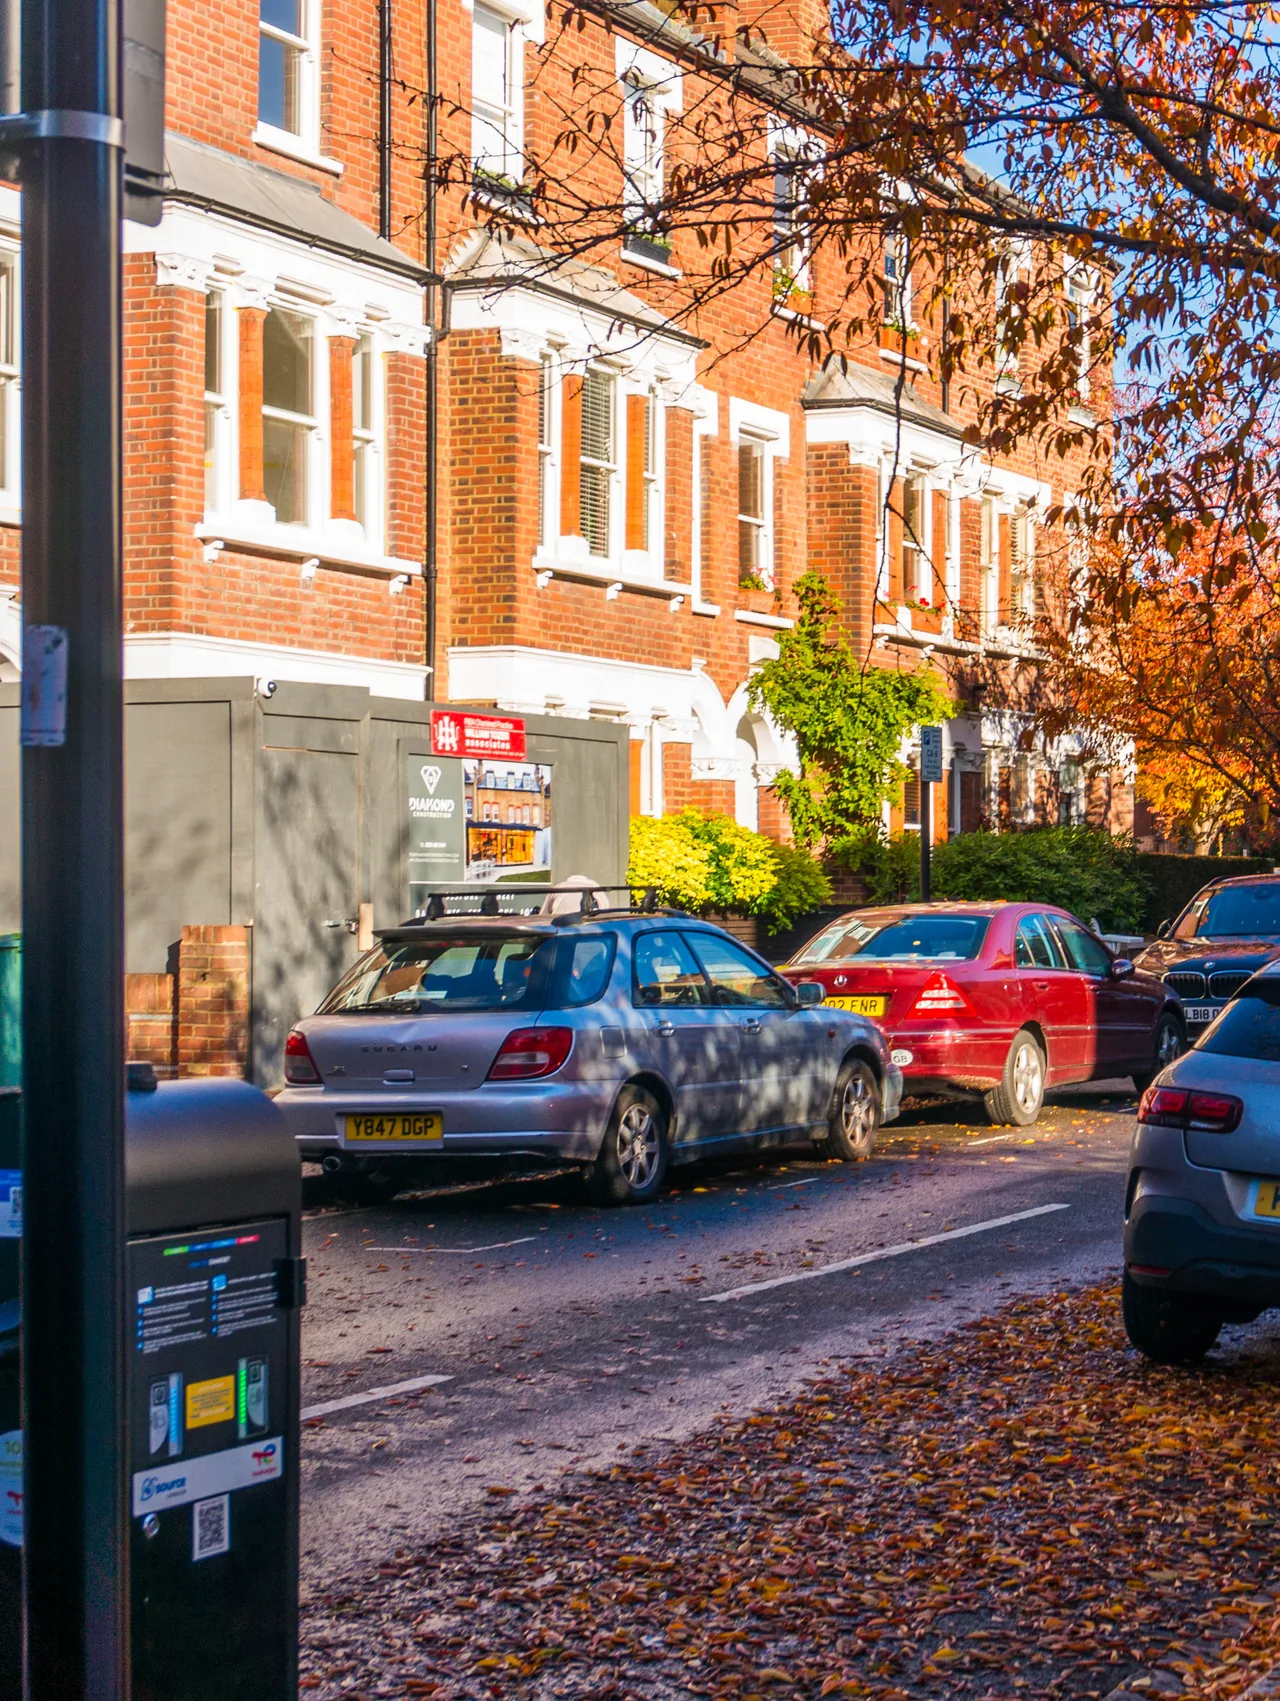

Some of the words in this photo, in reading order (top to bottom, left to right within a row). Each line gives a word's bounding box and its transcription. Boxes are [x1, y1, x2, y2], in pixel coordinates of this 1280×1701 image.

[464, 738, 511, 750] associates
[409, 797, 455, 812] DIAMOND
[360, 1044, 439, 1053] SUBARU
[893, 1055, 908, 1064] GB
[353, 1118, 397, 1137] Y847
[401, 1117, 435, 1137] DGP
